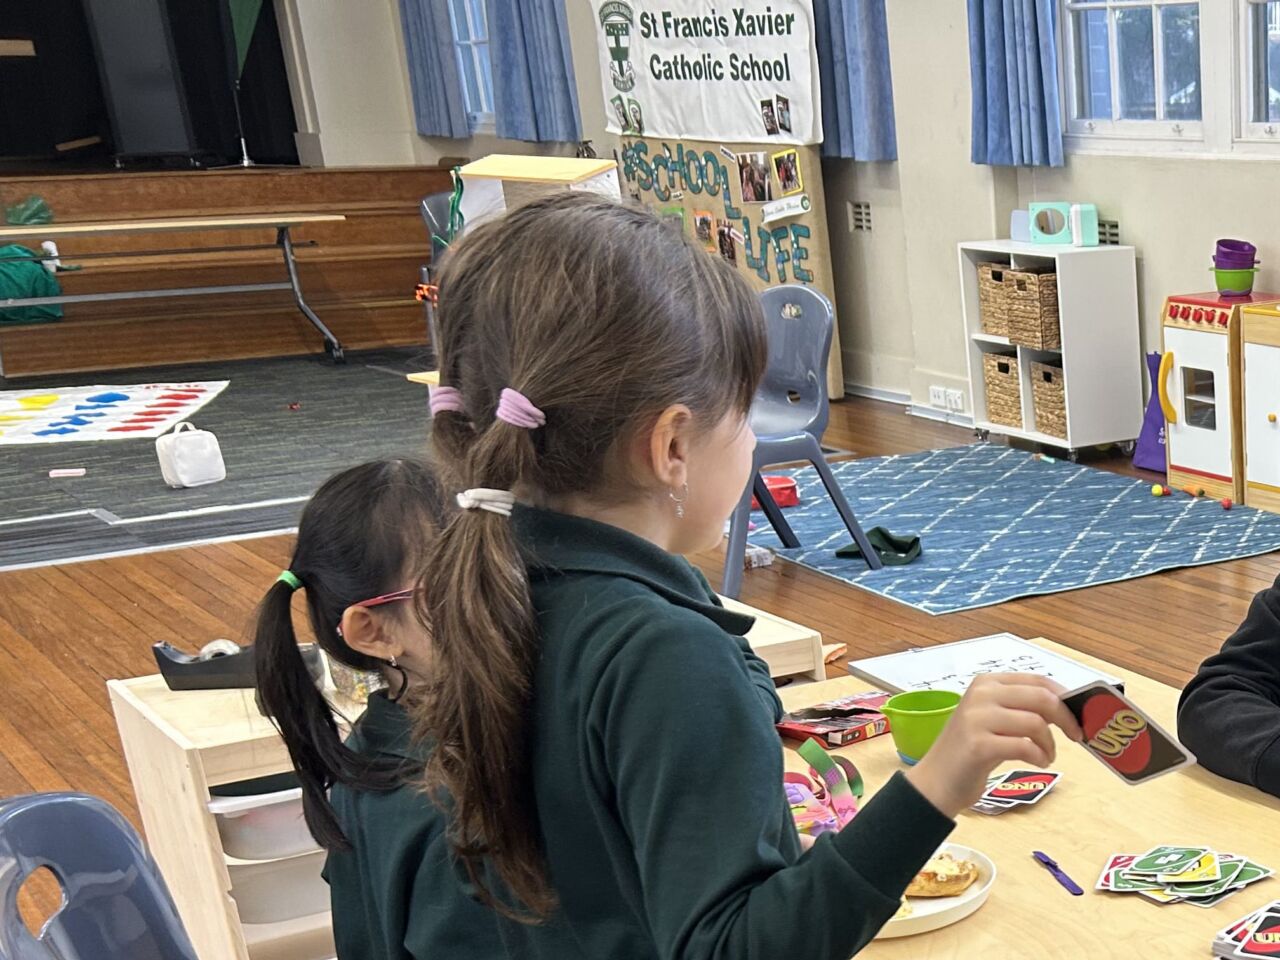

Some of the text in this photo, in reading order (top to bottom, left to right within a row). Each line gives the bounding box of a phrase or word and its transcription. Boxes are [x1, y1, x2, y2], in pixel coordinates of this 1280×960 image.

[640, 11, 659, 39] St
[662, 11, 729, 38] Francis
[732, 7, 795, 37] Xavier
[650, 53, 791, 82] Catholic School
[743, 217, 814, 283] LIFE
[1087, 709, 1148, 758] UNO
[996, 780, 1047, 790] UNO
